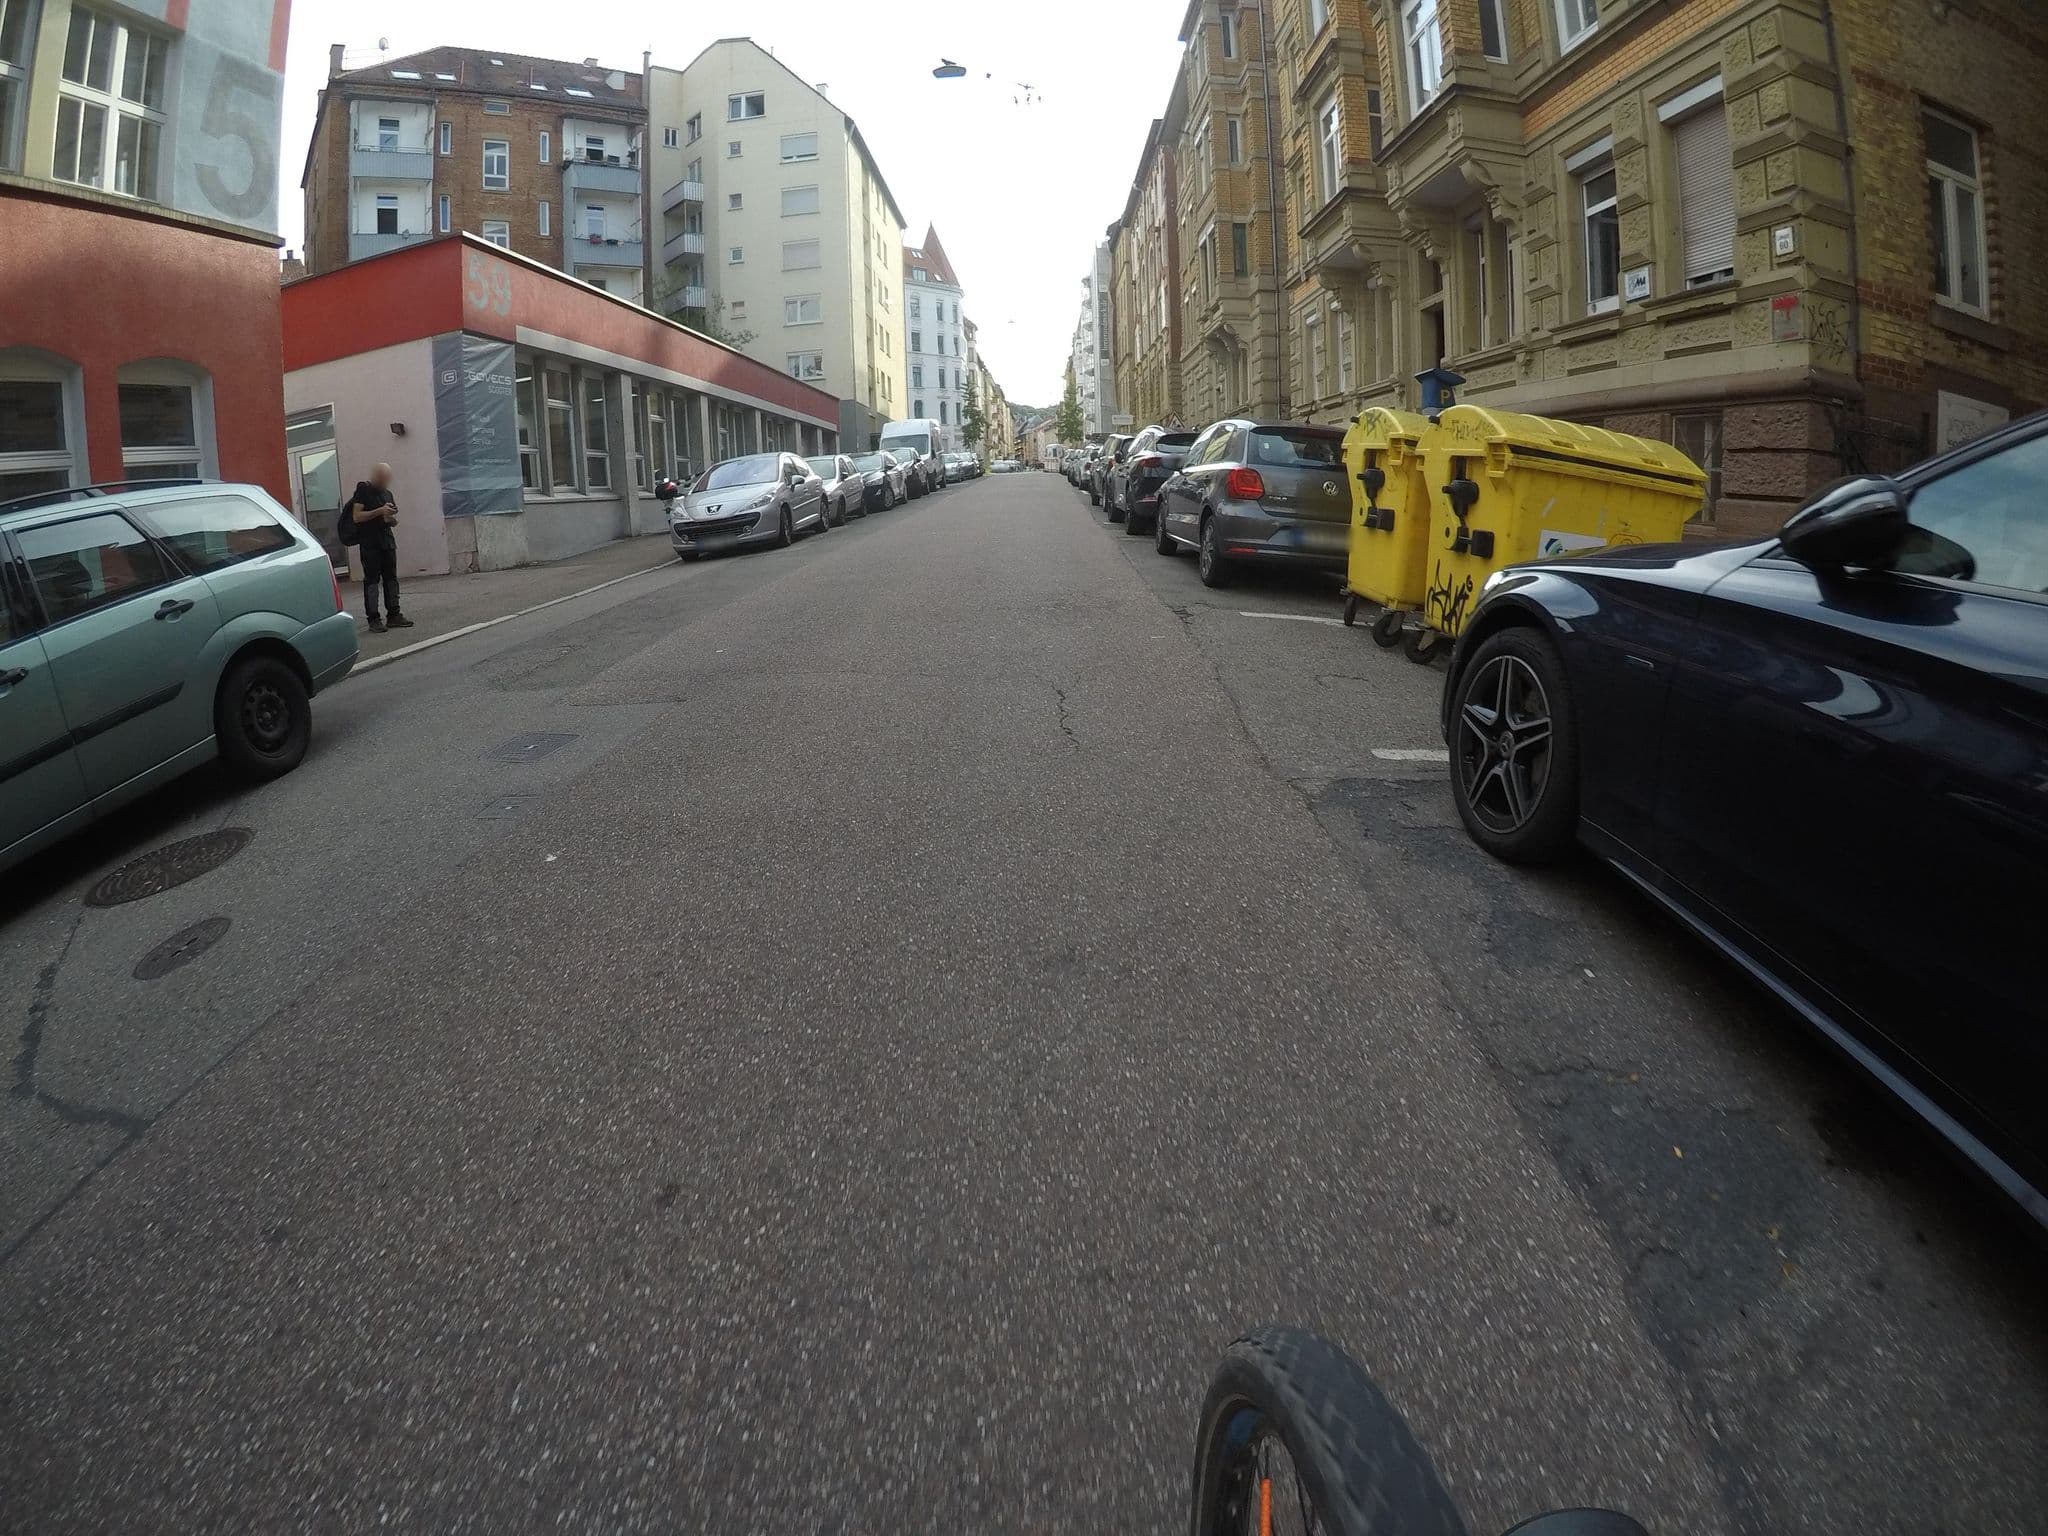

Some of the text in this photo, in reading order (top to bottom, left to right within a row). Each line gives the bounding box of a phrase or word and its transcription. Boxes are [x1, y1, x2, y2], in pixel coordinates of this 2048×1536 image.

[193, 52, 283, 219] 5
[467, 252, 512, 317] 59
[468, 371, 512, 386] GOVECS
[1440, 389, 1450, 404] P
